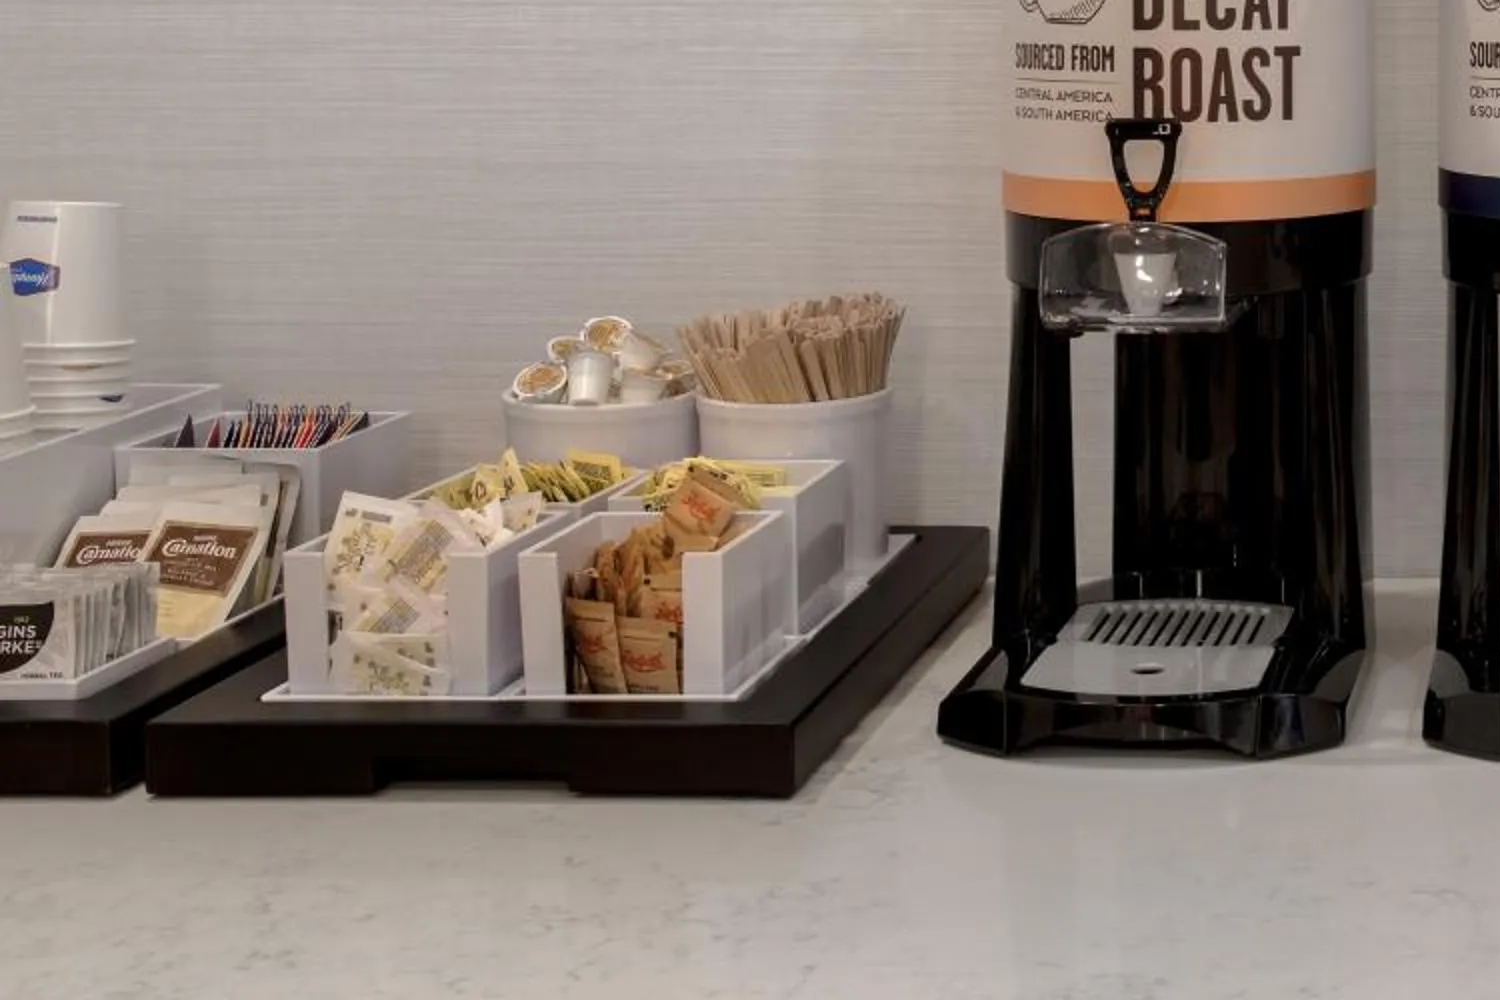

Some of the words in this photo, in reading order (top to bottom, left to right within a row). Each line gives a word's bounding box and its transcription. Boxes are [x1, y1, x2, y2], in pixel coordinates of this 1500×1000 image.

[1015, 42, 1065, 71] SOURCED
[1071, 44, 1115, 73] FROM
[1132, 46, 1301, 123] ROAST
[1056, 89, 1113, 103] AMERICA
[1055, 109, 1113, 122] AMERICA
[75, 545, 141, 565] Carnatio
[161, 538, 237, 560] Carnation
